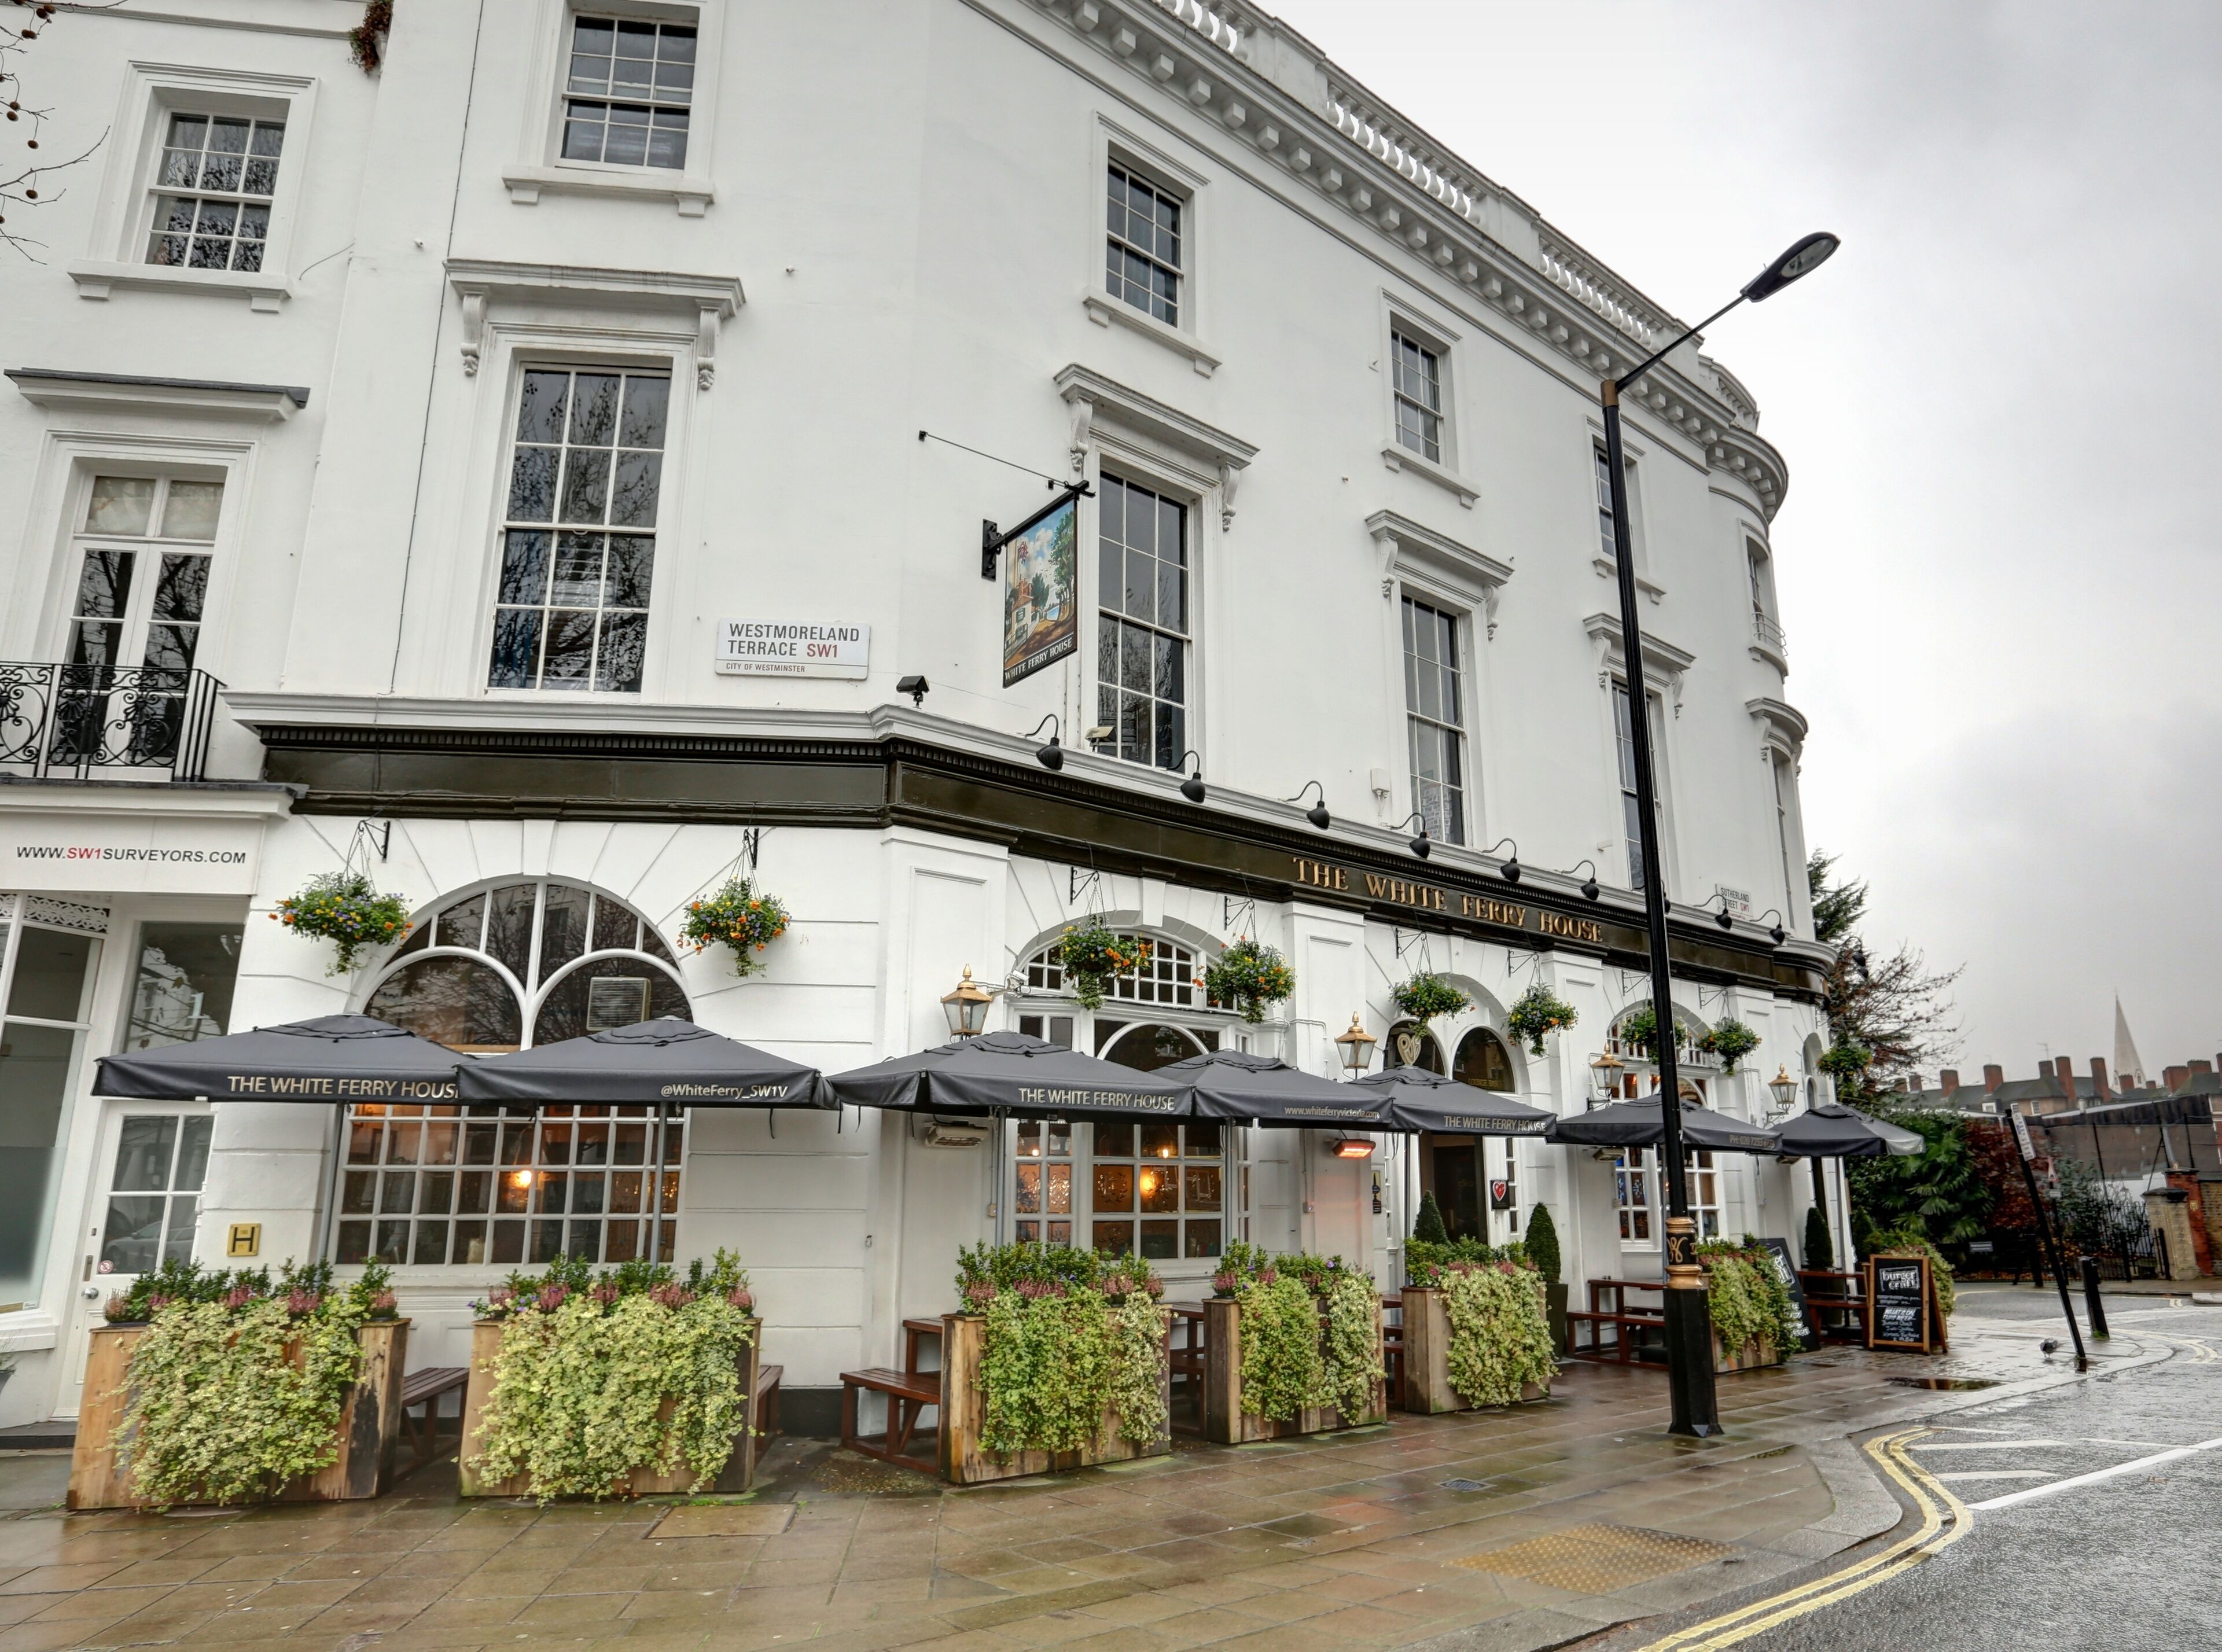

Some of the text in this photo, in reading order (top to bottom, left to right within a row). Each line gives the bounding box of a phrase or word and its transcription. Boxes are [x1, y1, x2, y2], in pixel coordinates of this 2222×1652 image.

[729, 623, 860, 642] WESTMORELAND
[727, 640, 838, 658] TERRACE SW1
[755, 664, 805, 672] WESTMINSTER
[1005, 639, 1072, 680] WHITE FERRY HOUSE
[16, 846, 247, 864] WWW.SW1SURVEYORS.COM
[1292, 856, 1603, 943] THE WHITE FERRY HOUSE
[1720, 887, 1749, 903] SUTHERLAND
[227, 1076, 459, 1099] THE WHITE FERRY HOUS
[661, 1084, 788, 1099] @WhiteFerry_SW1V
[1018, 1087, 1176, 1110] THE WHITE FERRY HOUSE
[1444, 1116, 1547, 1132] THE WHITE FERRY HOUSE
[232, 1226, 255, 1253] H
[1882, 1270, 1915, 1283] burger
[1888, 1279, 1916, 1290] craft
